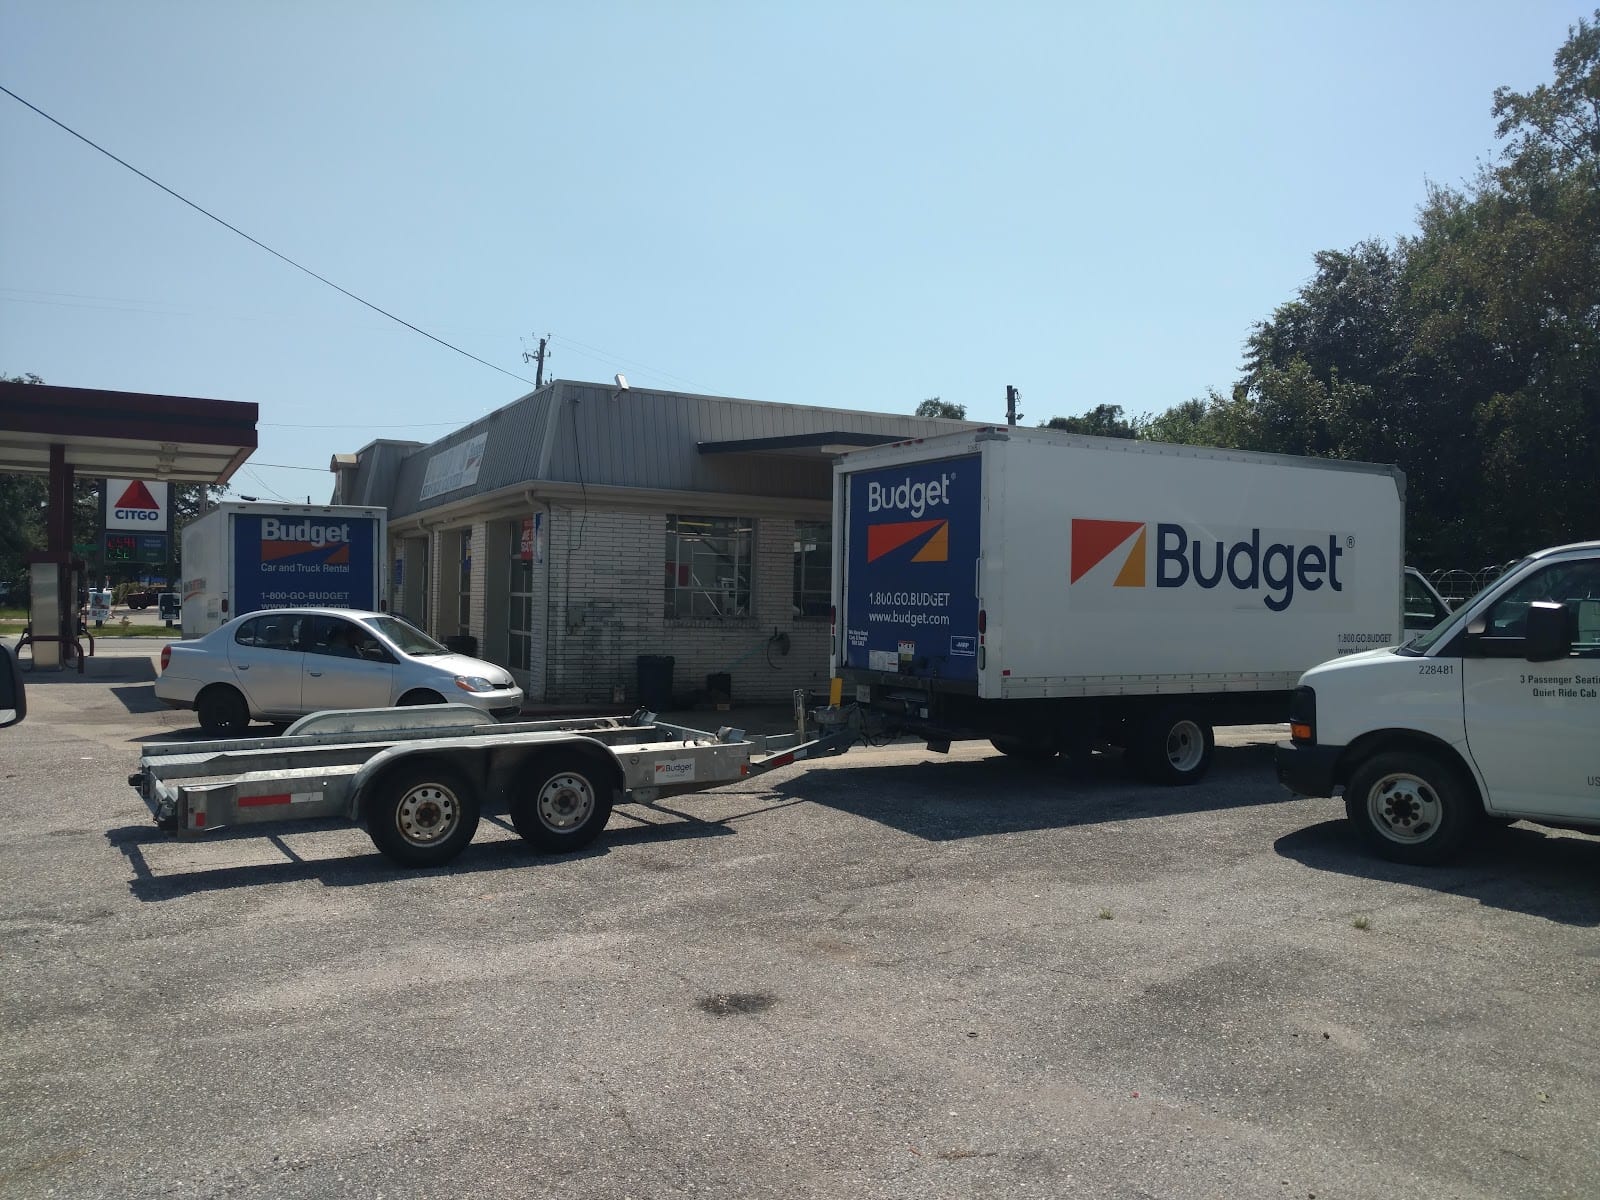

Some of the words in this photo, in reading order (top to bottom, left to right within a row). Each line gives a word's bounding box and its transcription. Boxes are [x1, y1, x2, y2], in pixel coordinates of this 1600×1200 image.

[868, 473, 949, 518] Budget
[115, 509, 159, 521] CITGO
[261, 518, 350, 547] Budget
[261, 563, 276, 572] Car
[278, 564, 295, 572] and
[296, 564, 320, 573] Truck
[322, 564, 350, 573] Rental
[1156, 523, 1343, 612] Budget
[261, 592, 350, 600] 1-800-GO-BUDGET
[868, 592, 950, 606] 1.800.GO.BUDGET
[261, 602, 350, 610] www.budgetcom
[868, 610, 950, 627] www.budget.com
[1337, 633, 1392, 643] 1.800.GO.BUDGET
[1418, 665, 1454, 675] 228481
[1520, 675, 1526, 684] 3
[1528, 675, 1572, 686] Passenger
[1575, 675, 1600, 684] Seati
[1558, 688, 1578, 698] Ride
[1580, 688, 1597, 698] Cab
[665, 763, 692, 773] Budget
